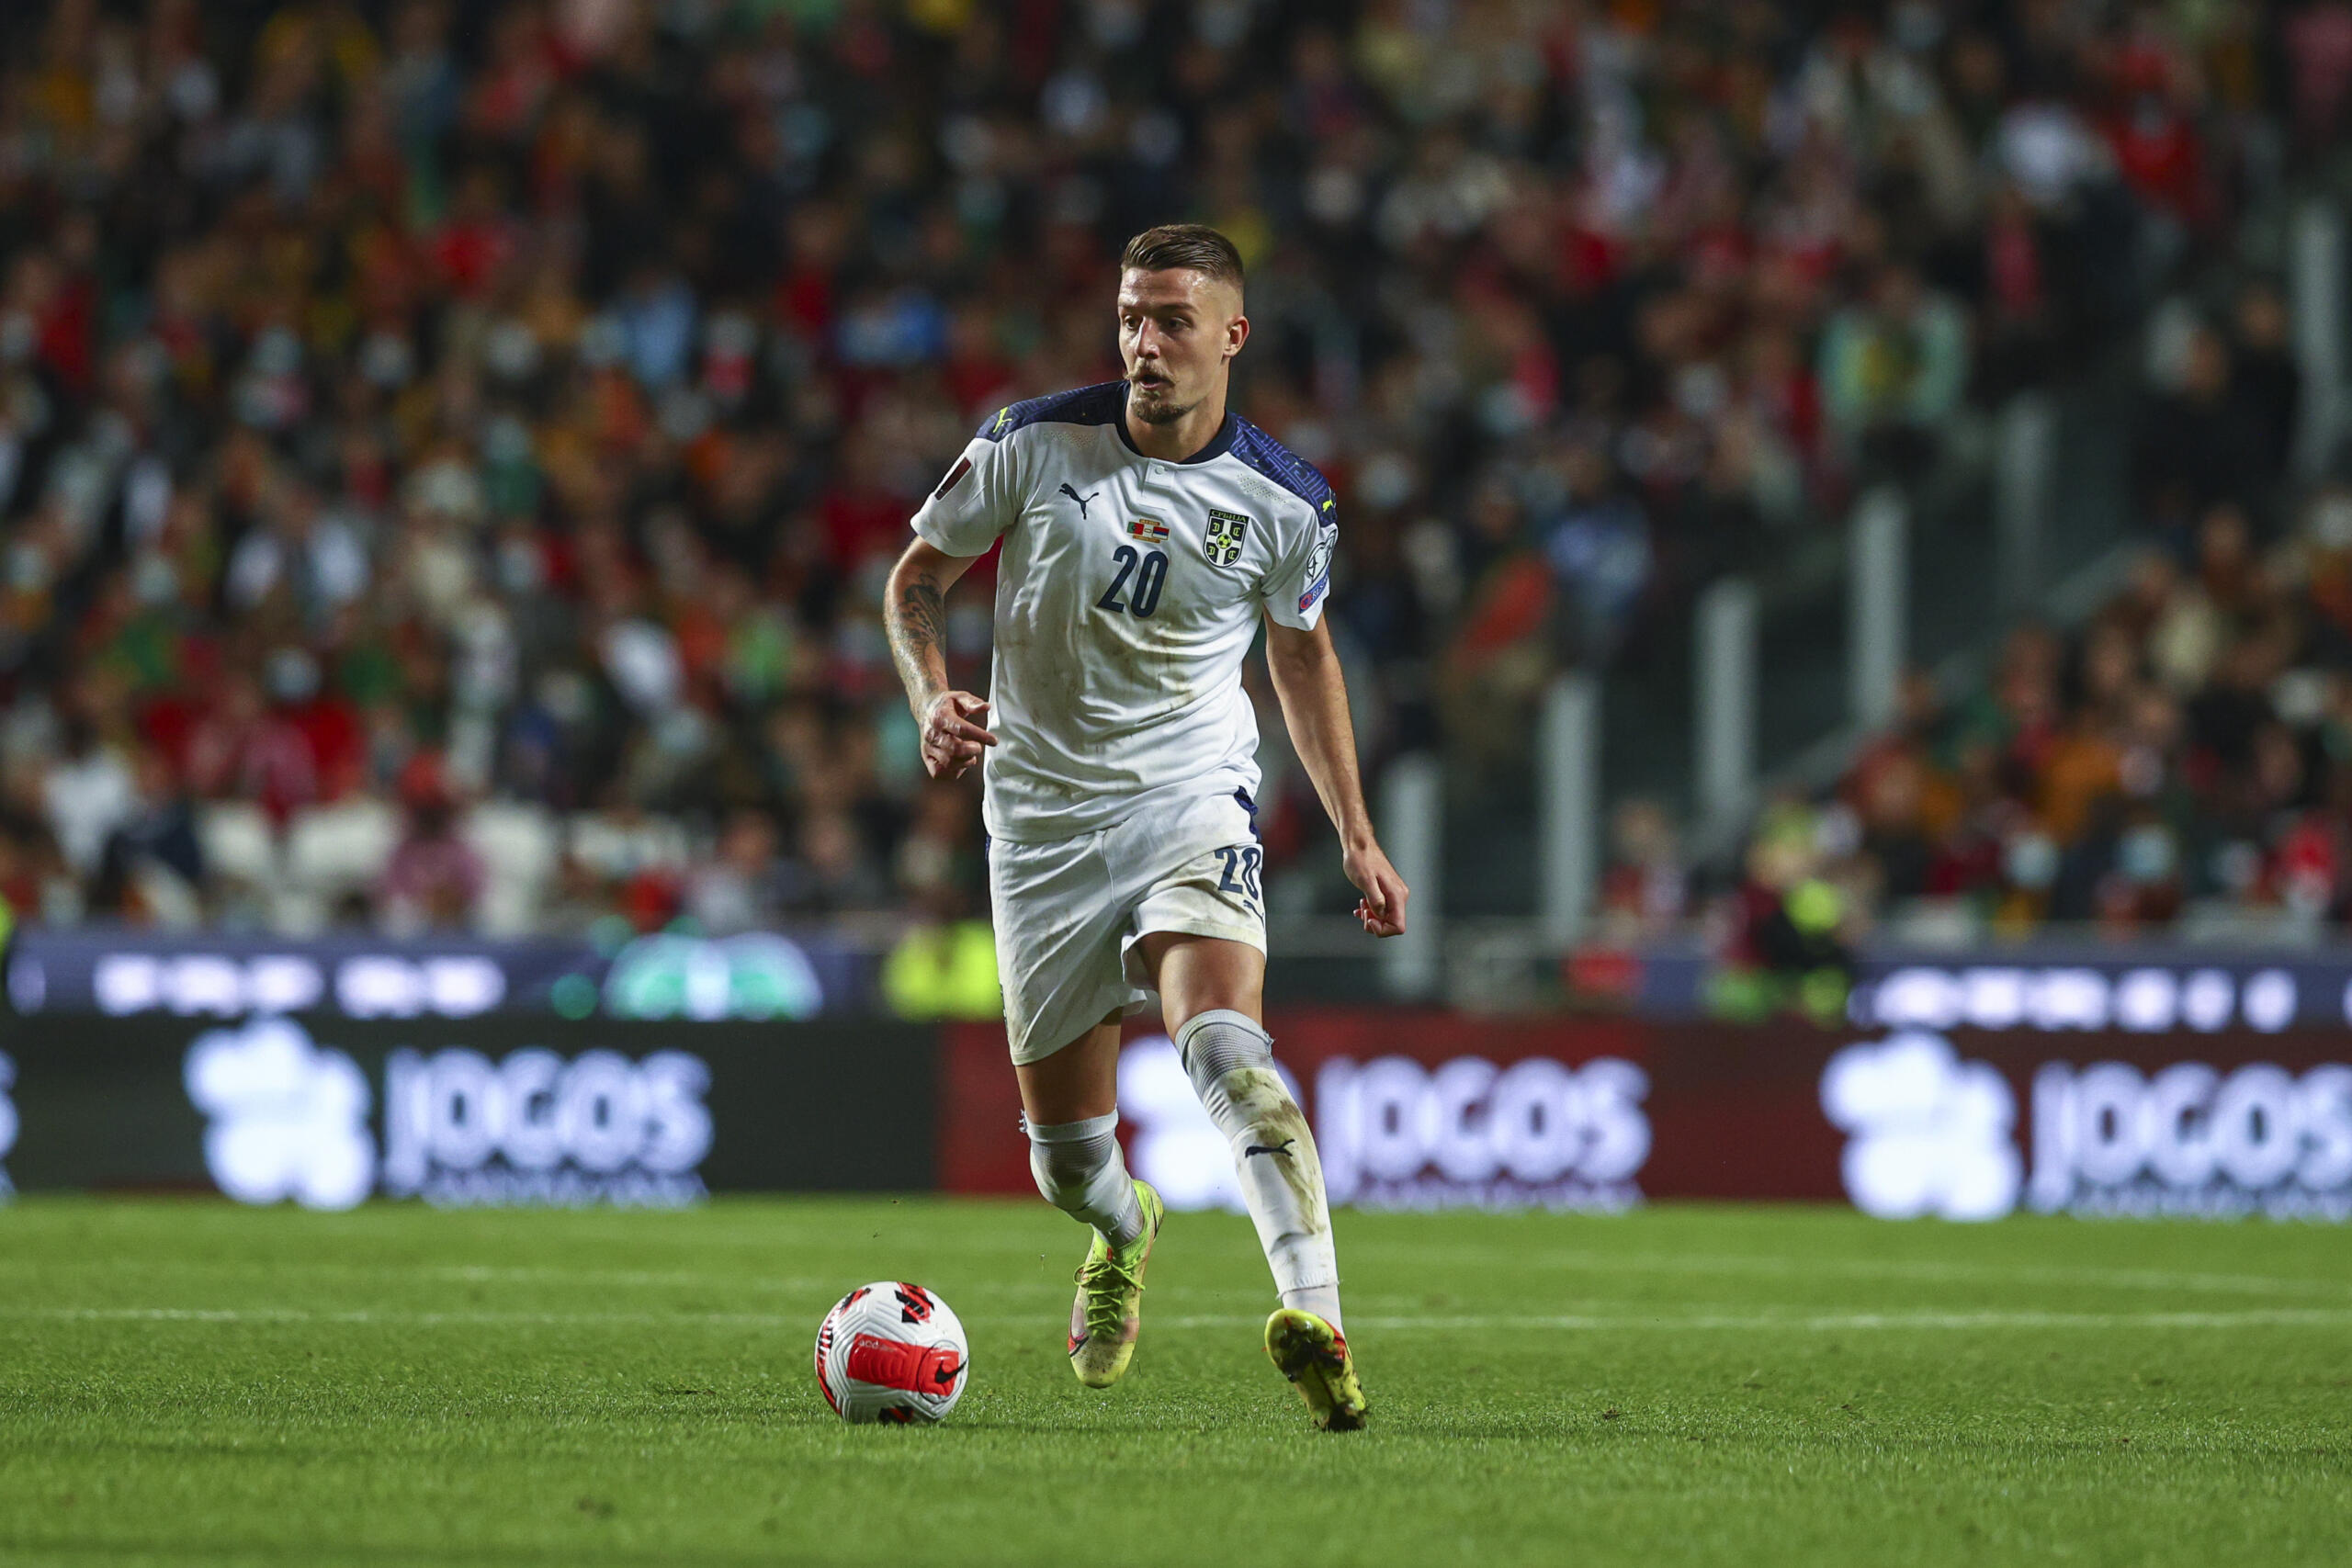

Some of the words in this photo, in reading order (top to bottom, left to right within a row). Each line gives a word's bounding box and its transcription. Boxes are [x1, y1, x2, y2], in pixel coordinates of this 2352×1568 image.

[1096, 545, 1169, 617] 20
[1214, 847, 1261, 900] 20
[384, 1046, 714, 1197] JOGOS
[1315, 1054, 1652, 1205] JOGOS
